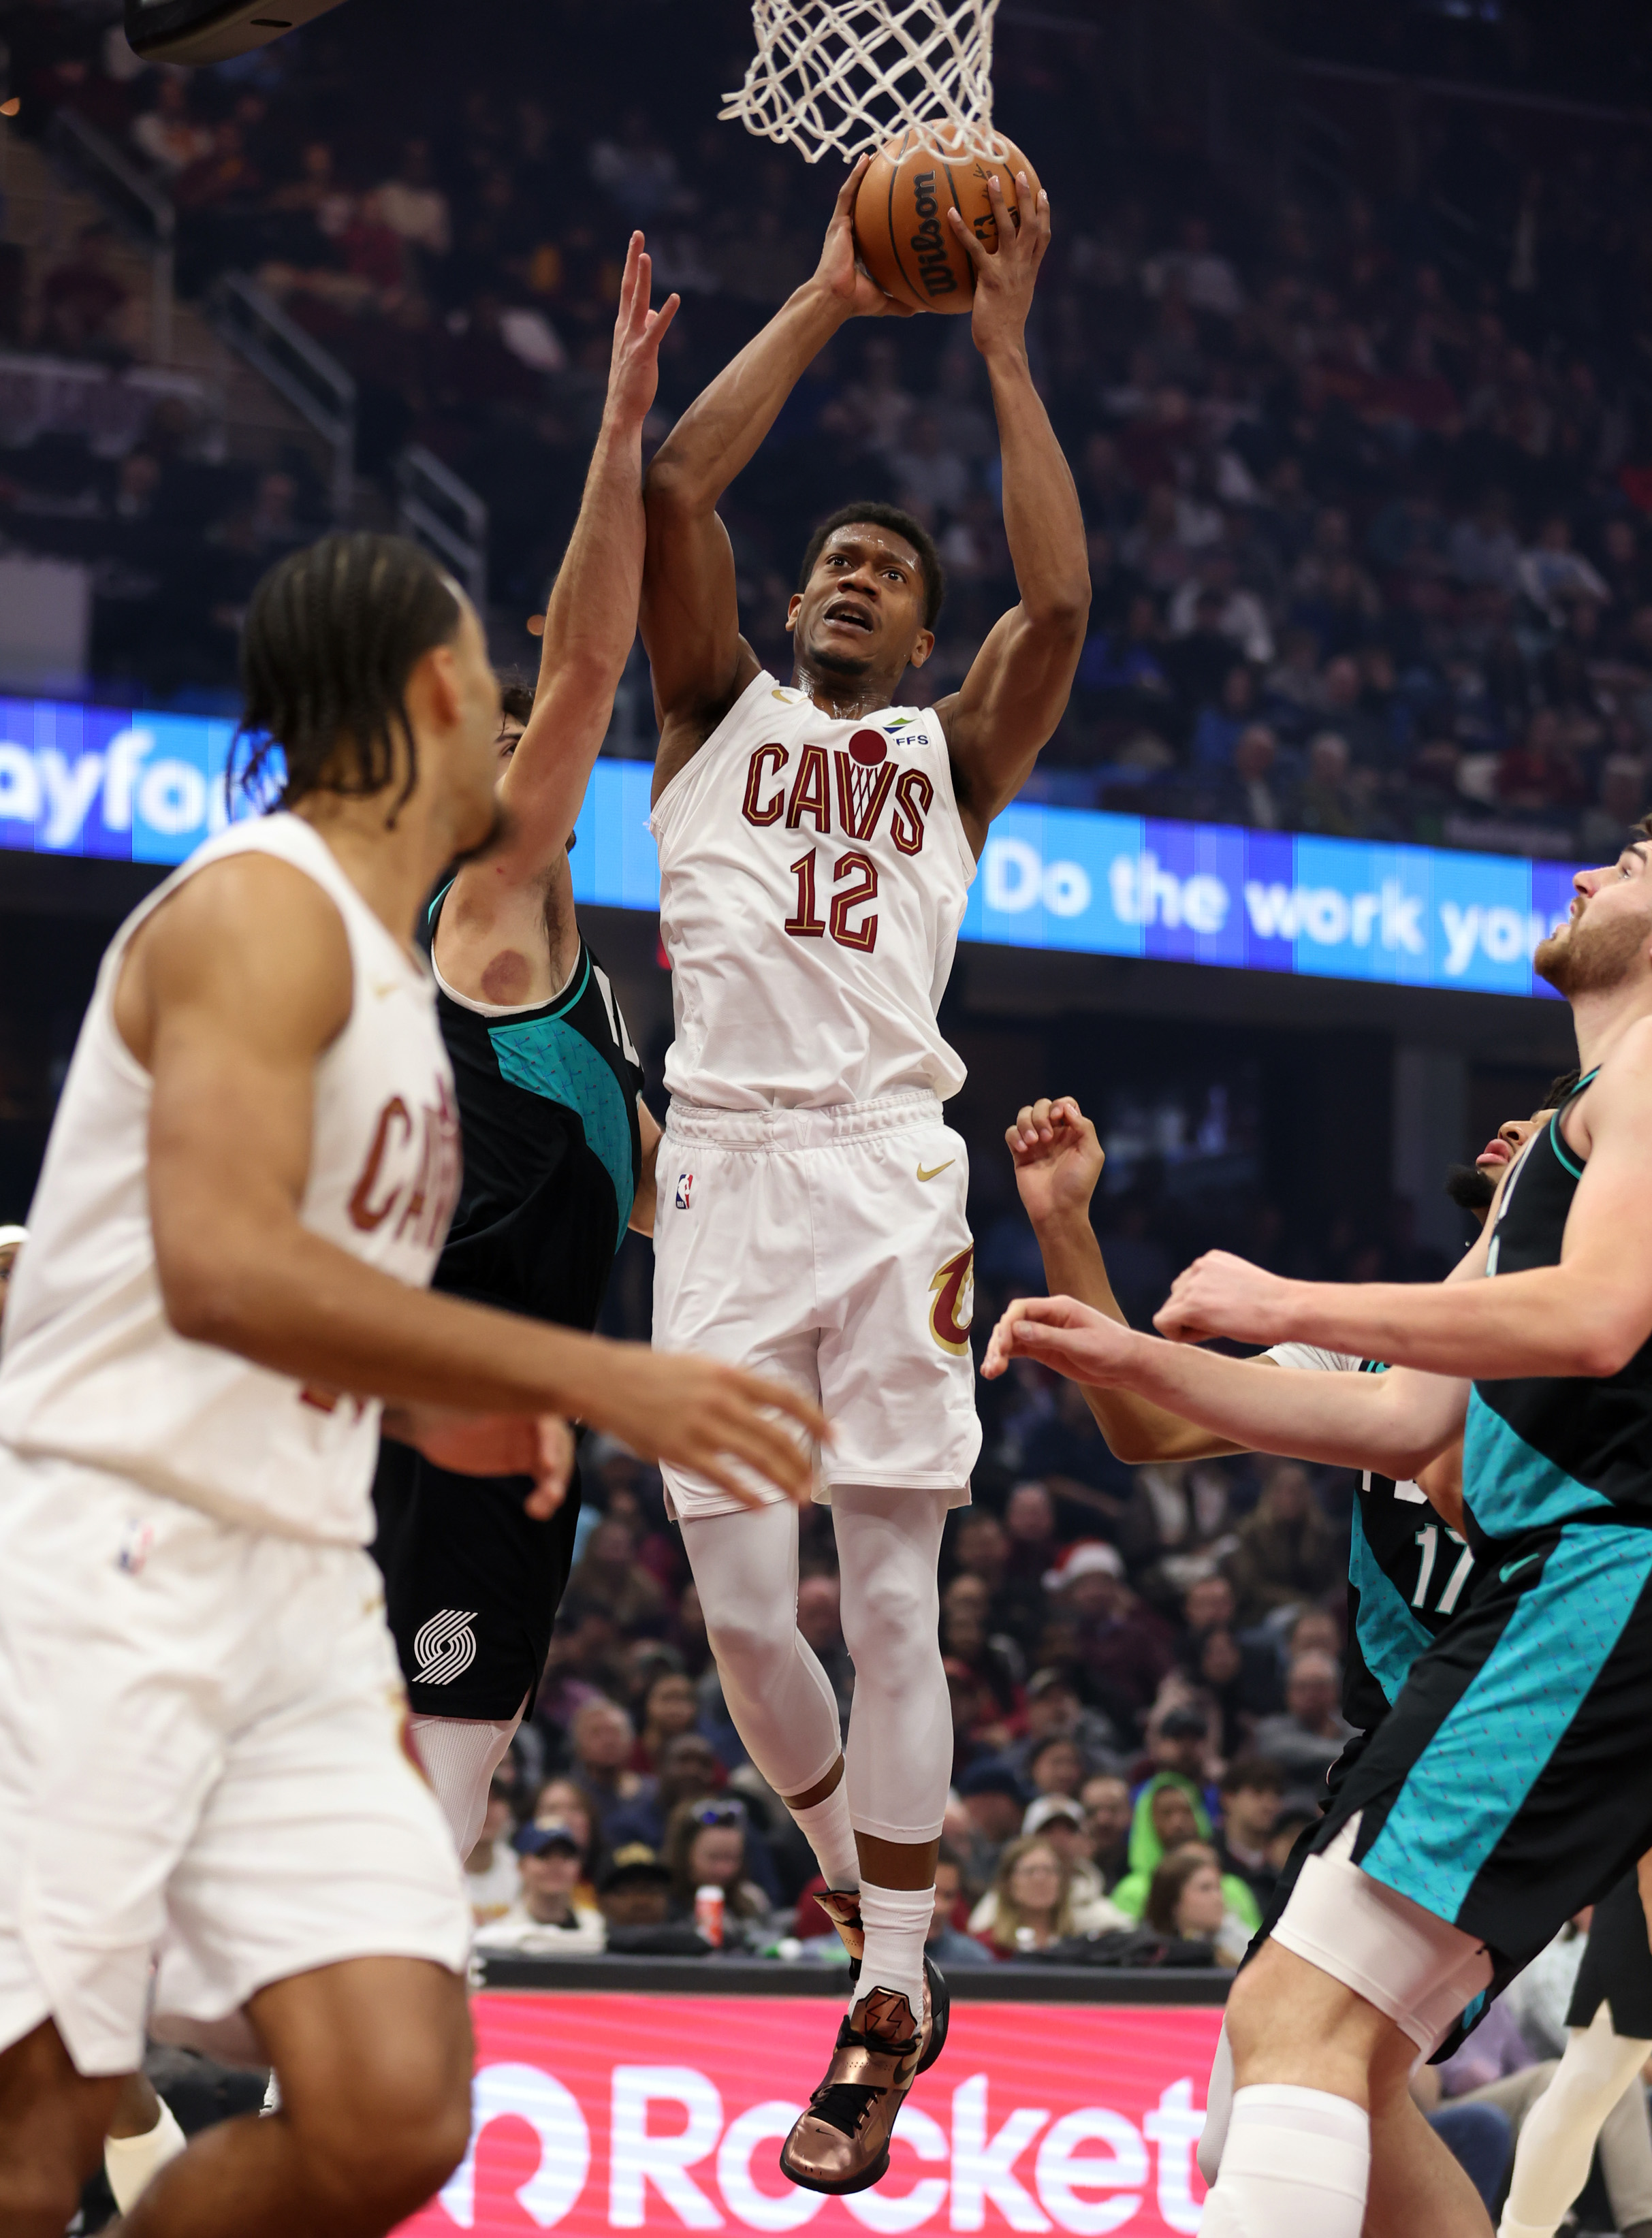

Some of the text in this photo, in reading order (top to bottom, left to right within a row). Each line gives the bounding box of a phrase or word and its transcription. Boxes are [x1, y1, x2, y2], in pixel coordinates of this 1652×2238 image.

[910, 170, 957, 298] Wilson
[742, 741, 934, 857] CAVS
[893, 735, 929, 747] FFS
[784, 846, 878, 954] 12
[985, 836, 1091, 920] Do
[1122, 849, 1230, 935] the
[1243, 877, 1425, 956] work
[1410, 1522, 1476, 1616] 17
[607, 2064, 1209, 2236] Rocket
